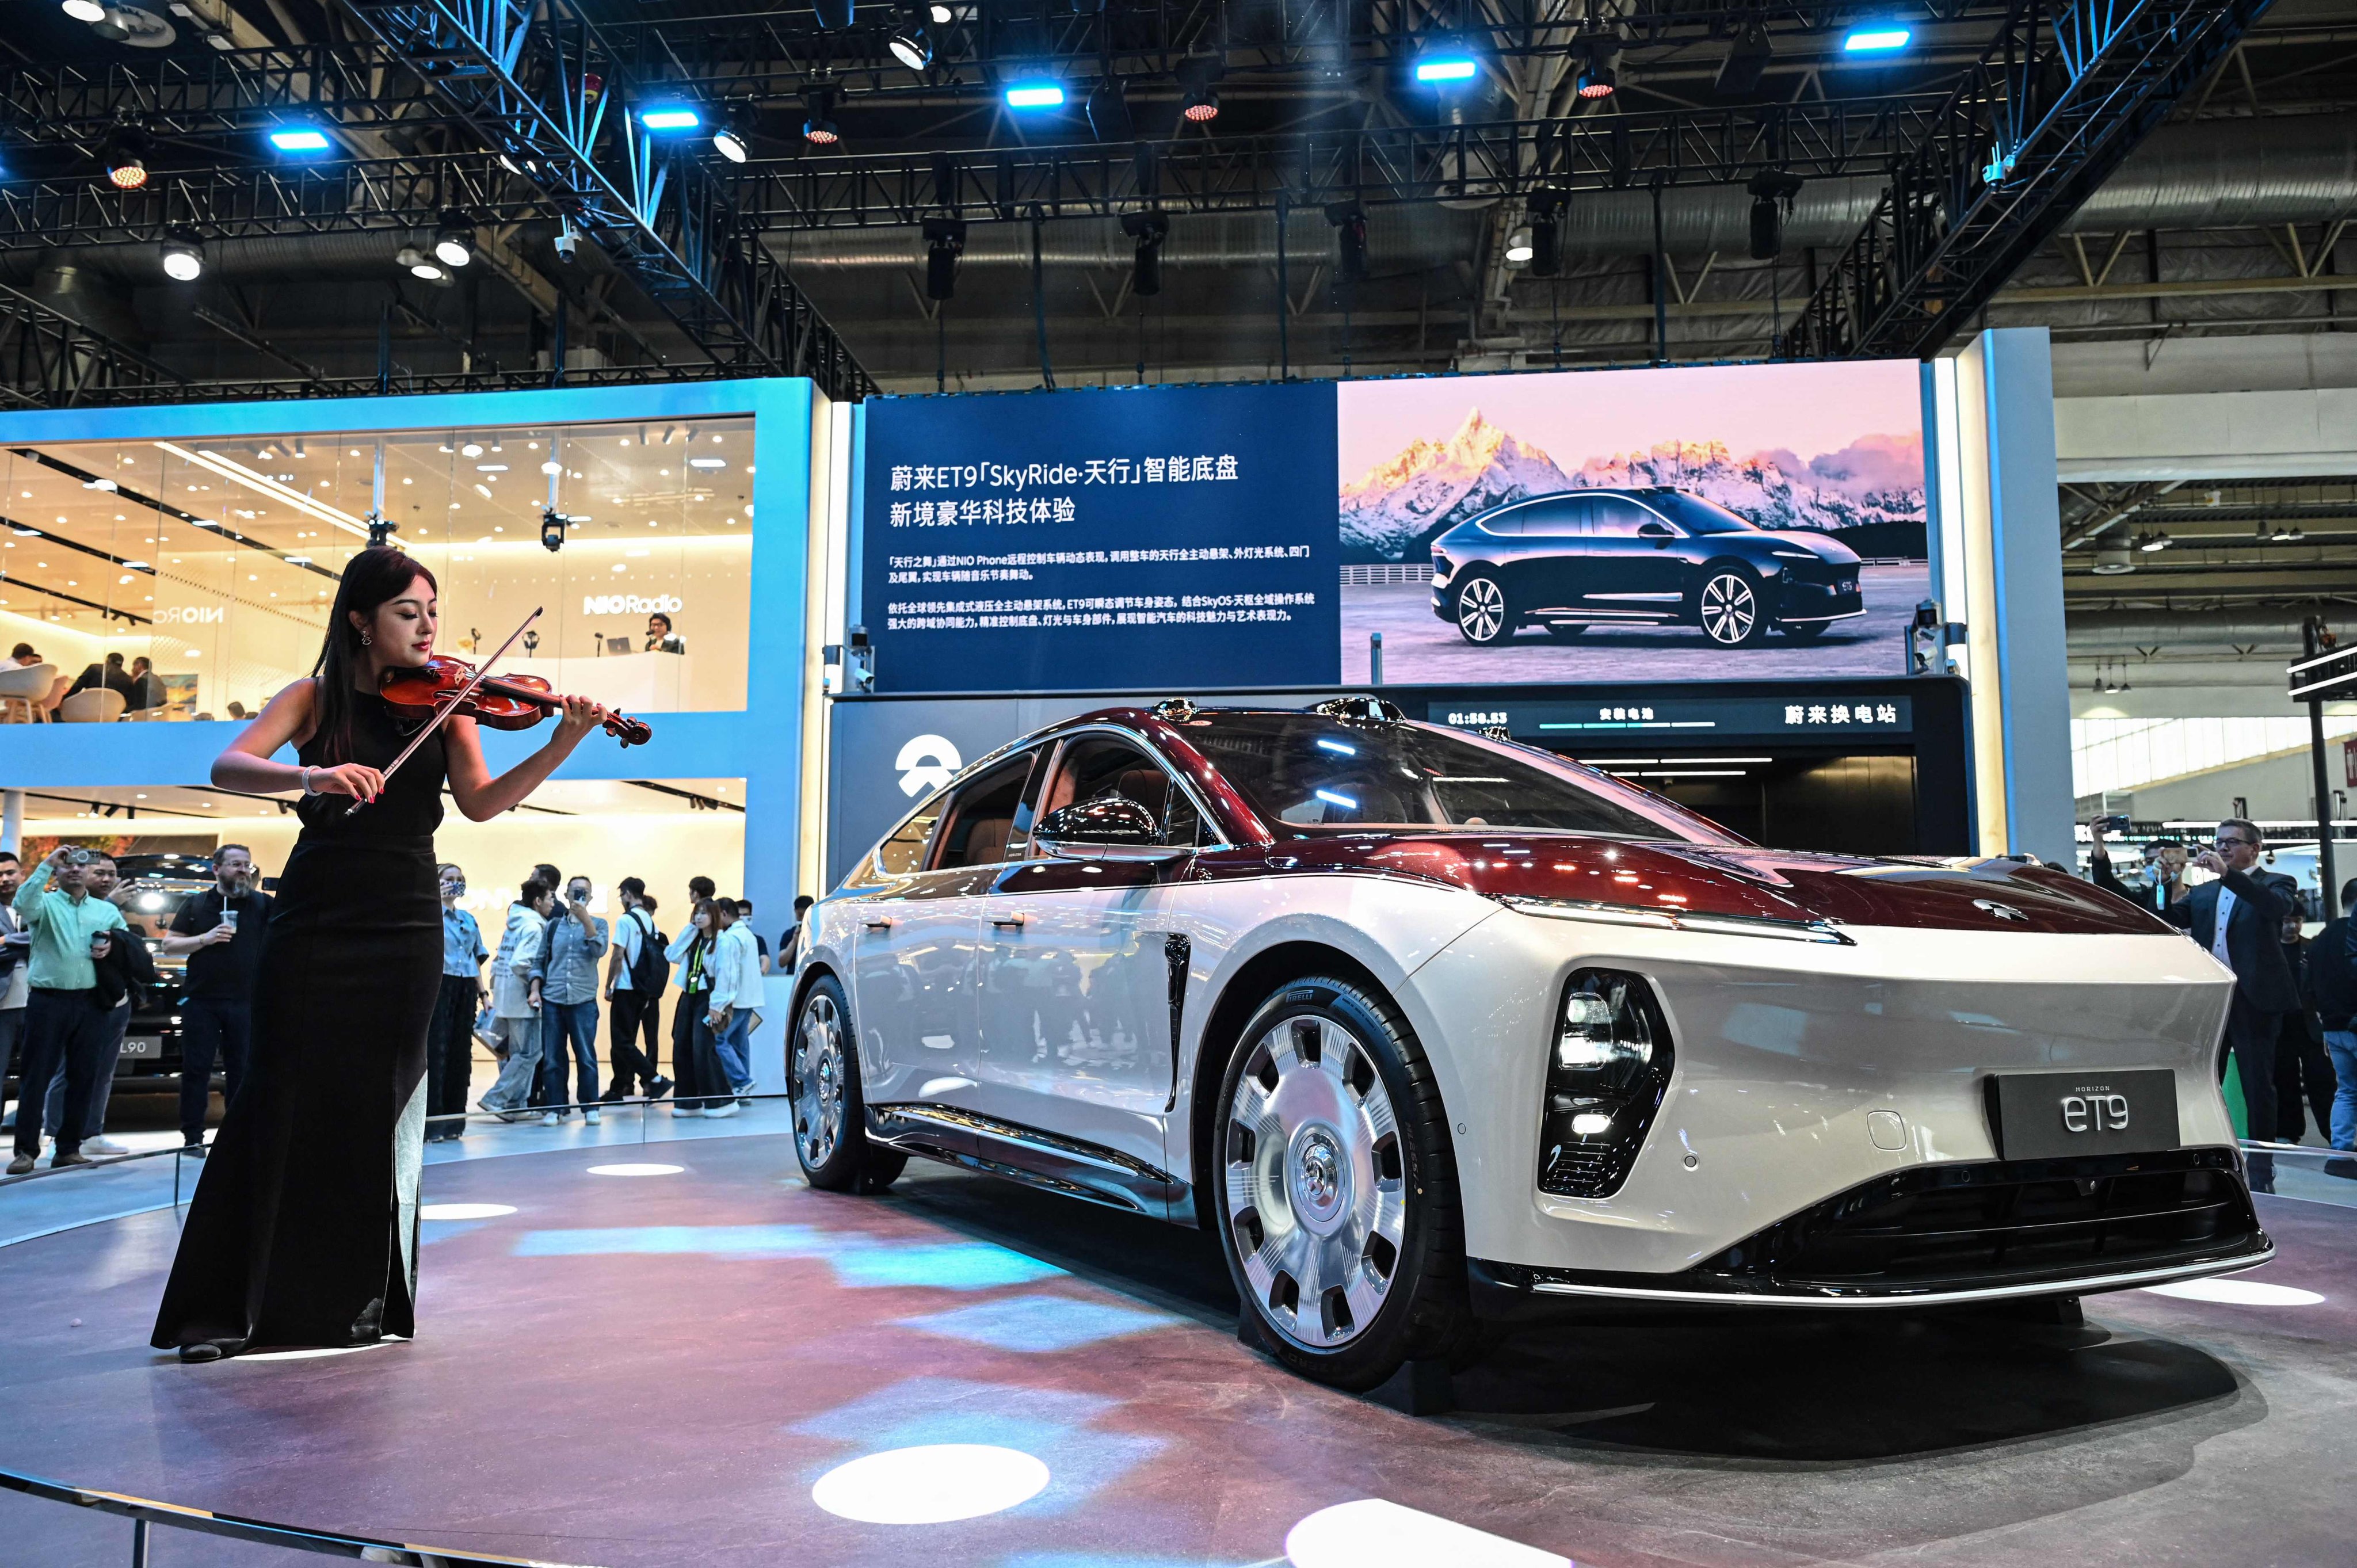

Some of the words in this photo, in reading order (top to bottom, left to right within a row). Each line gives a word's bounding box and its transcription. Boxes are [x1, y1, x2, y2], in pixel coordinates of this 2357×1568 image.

[890, 496, 1076, 528] 新境豪华科技体验
[1784, 704, 1896, 724] 蔚来换电站
[1286, 989, 1314, 1003] PIRELLI
